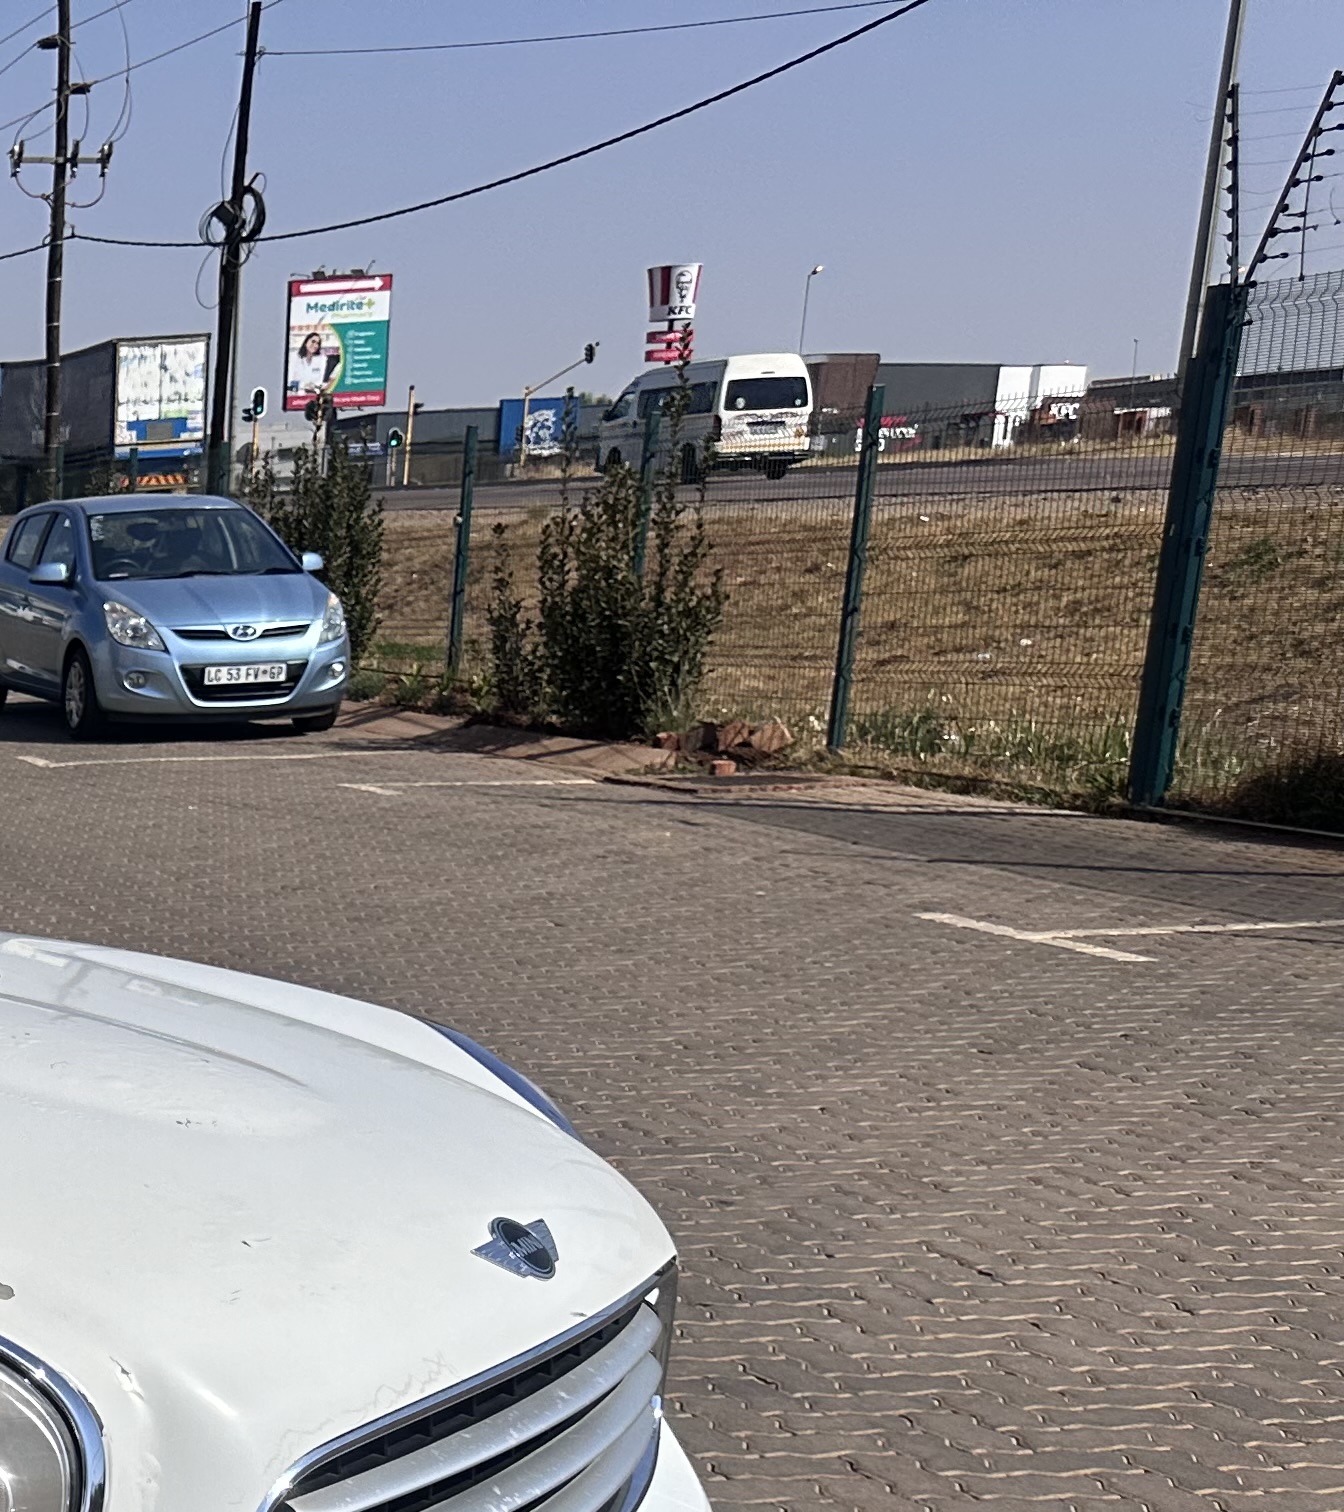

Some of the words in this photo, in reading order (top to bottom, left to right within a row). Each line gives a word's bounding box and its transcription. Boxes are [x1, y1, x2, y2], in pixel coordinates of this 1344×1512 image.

[667, 305, 692, 316] KFC
[226, 668, 241, 682] 53
[245, 667, 261, 681] FV
[269, 666, 284, 680] GP
